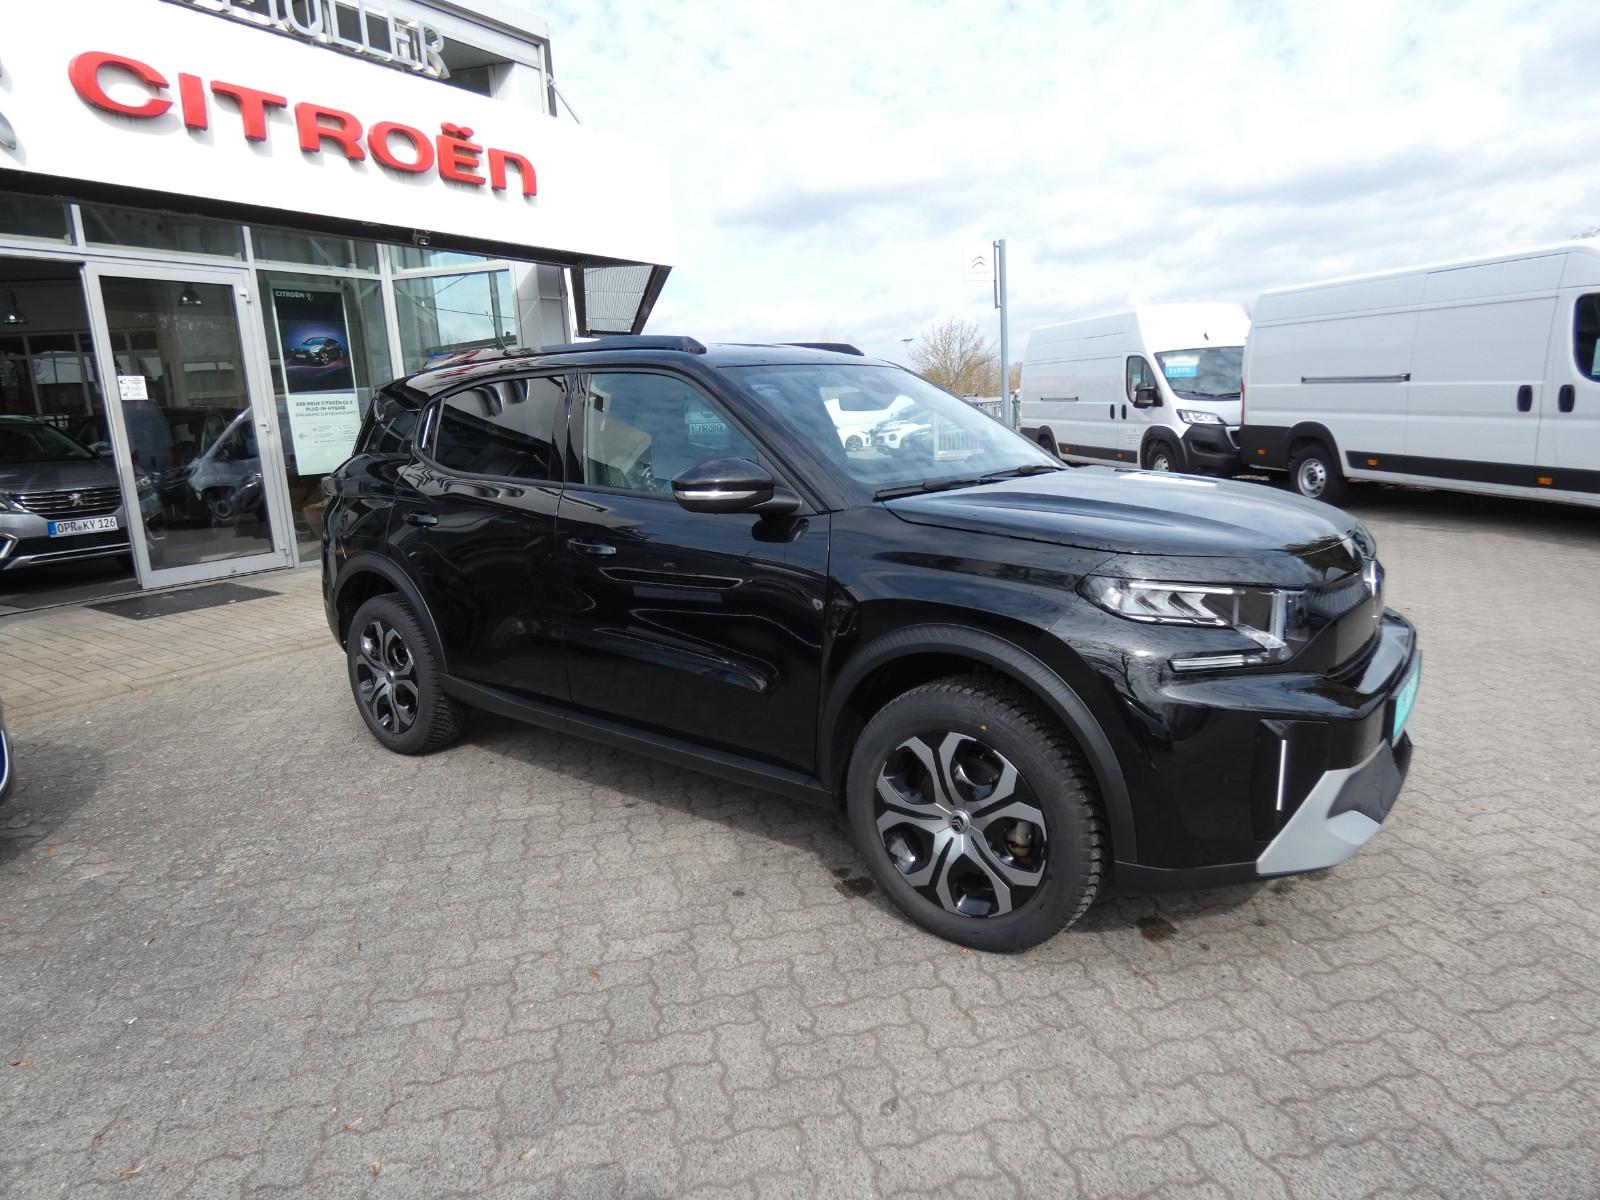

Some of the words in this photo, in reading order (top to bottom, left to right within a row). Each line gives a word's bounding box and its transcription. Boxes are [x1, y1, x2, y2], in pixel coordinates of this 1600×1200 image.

[57, 522, 77, 533] OPR
[83, 519, 95, 530] KY
[98, 518, 116, 529] 126
